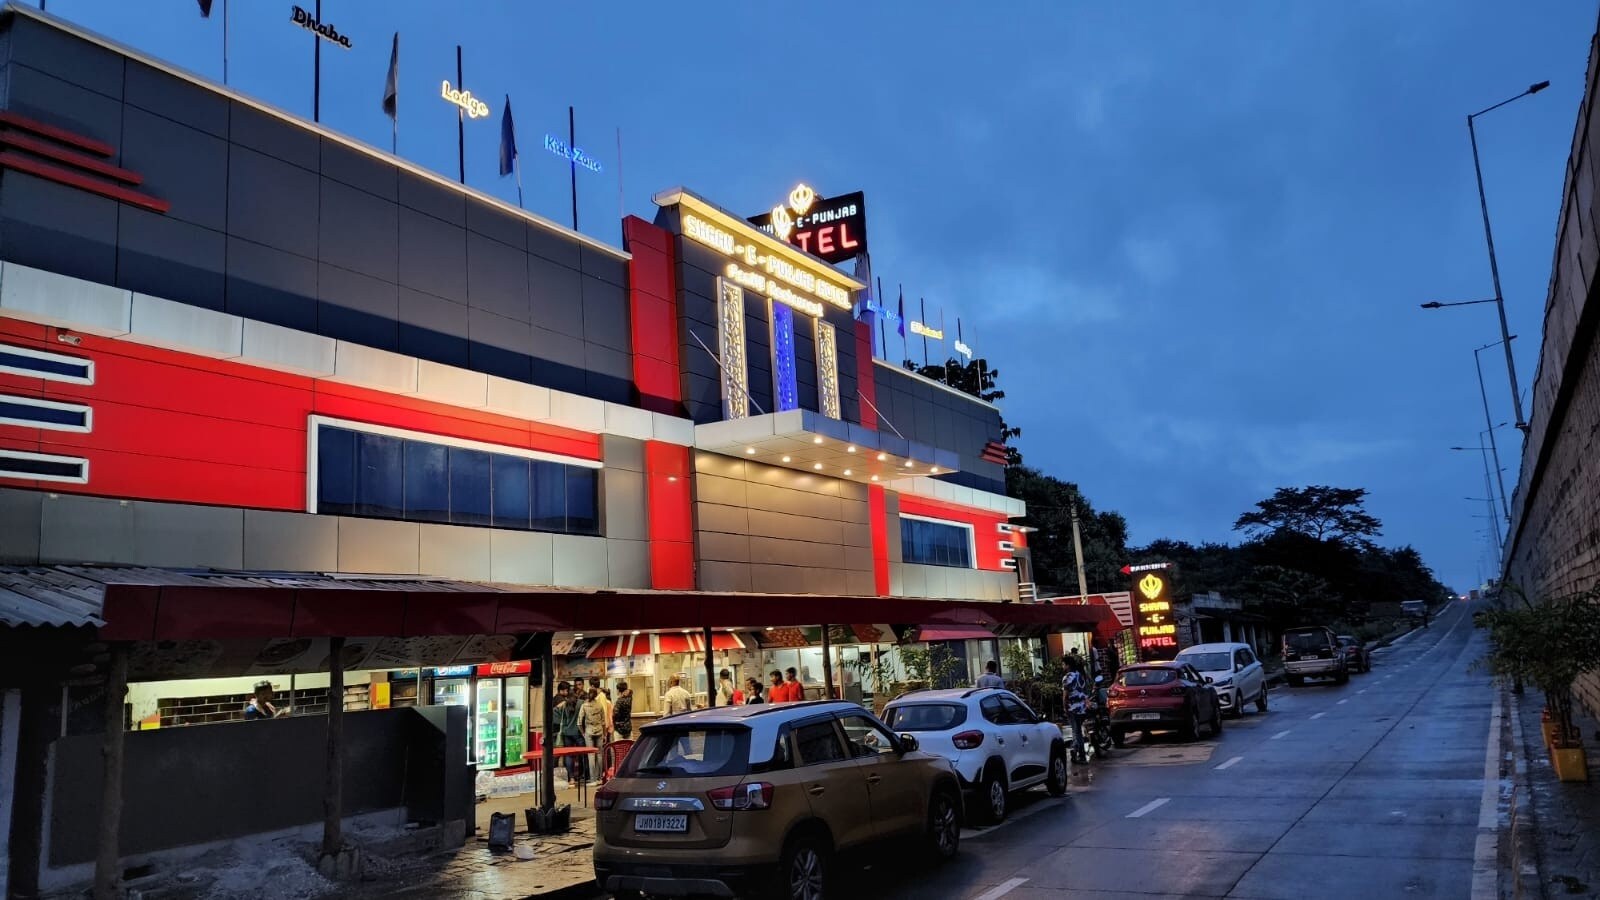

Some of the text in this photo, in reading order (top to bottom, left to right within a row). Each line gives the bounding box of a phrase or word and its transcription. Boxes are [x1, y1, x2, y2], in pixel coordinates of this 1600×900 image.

[290, 5, 353, 50] Dhaba
[442, 80, 489, 119] Lodge
[787, 223, 858, 254] TEL
[1141, 636, 1177, 647] HOTEL
[639, 815, 686, 830] JH01BY3224
